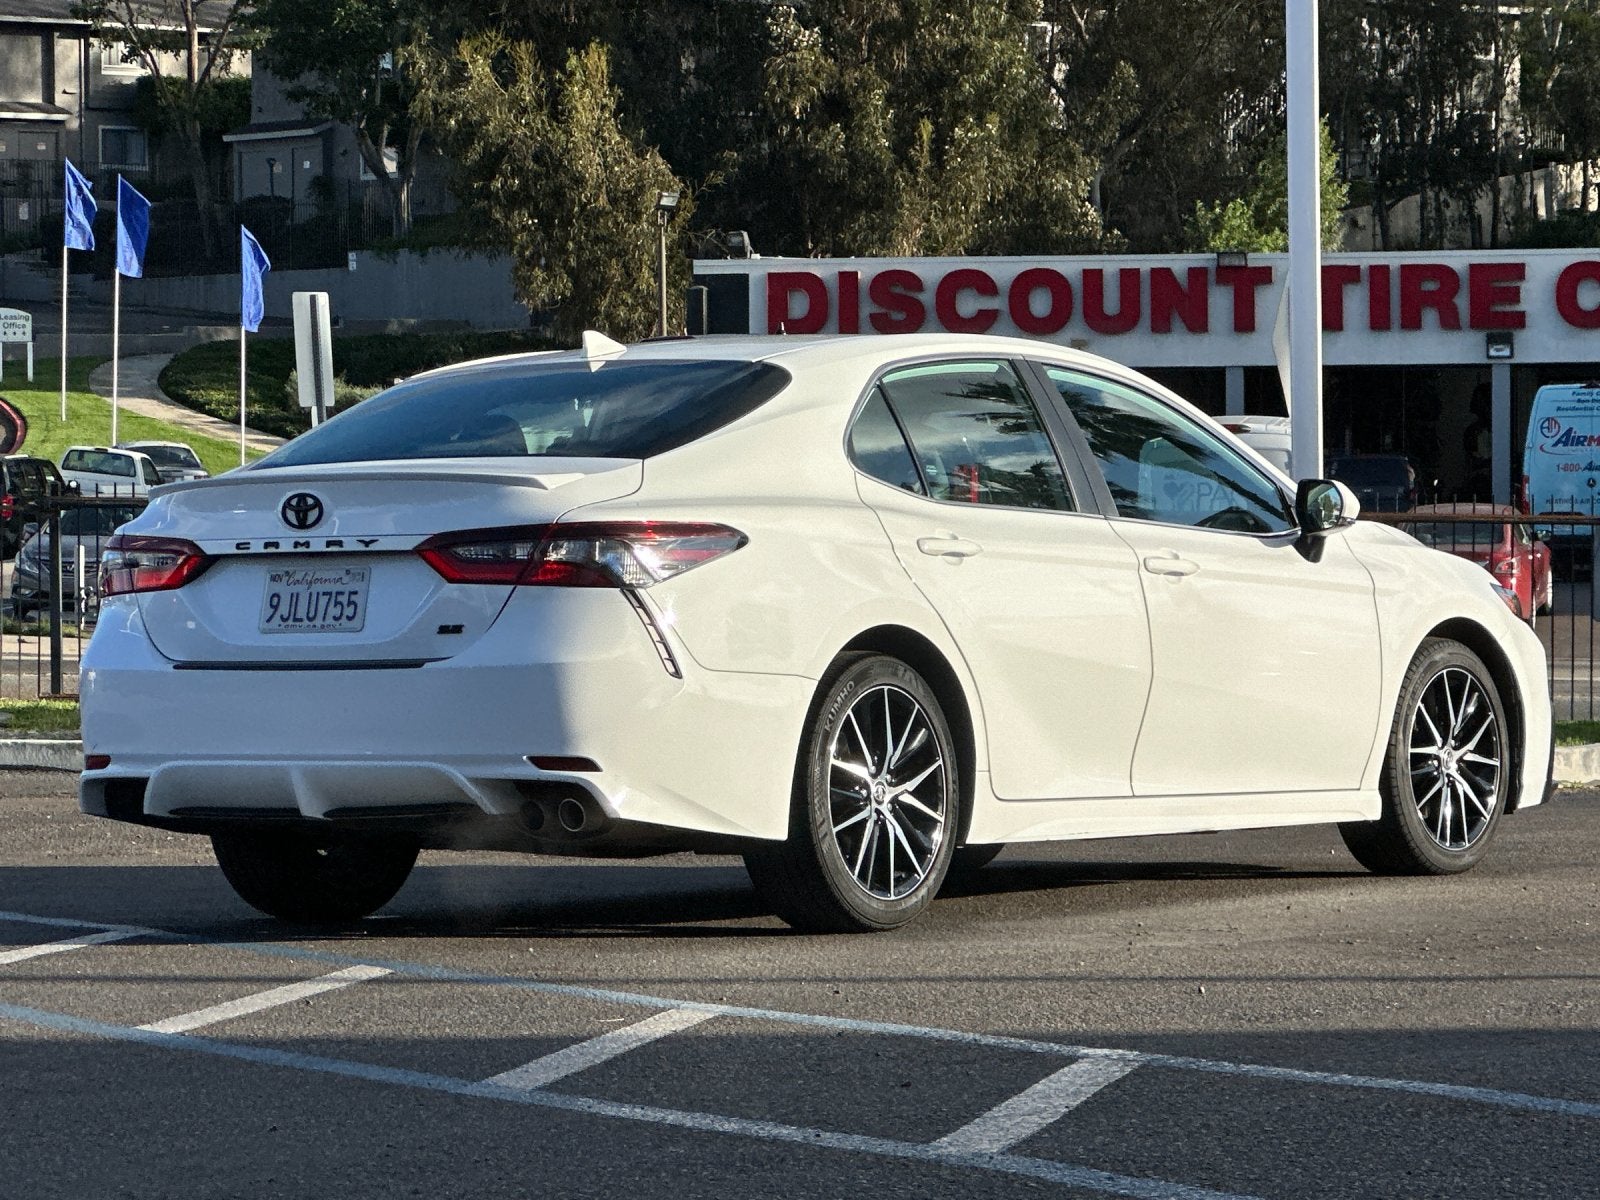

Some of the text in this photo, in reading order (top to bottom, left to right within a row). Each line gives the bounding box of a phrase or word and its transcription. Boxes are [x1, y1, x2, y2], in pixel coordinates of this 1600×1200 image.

[766, 264, 1274, 336] DISCOUNT
[1322, 263, 1526, 331] TIRE
[0, 313, 29, 321] Leasing
[235, 539, 379, 550] CAMRY
[285, 569, 347, 590] California
[265, 590, 359, 623] 9JLU755
[824, 680, 855, 731] KUMHO
